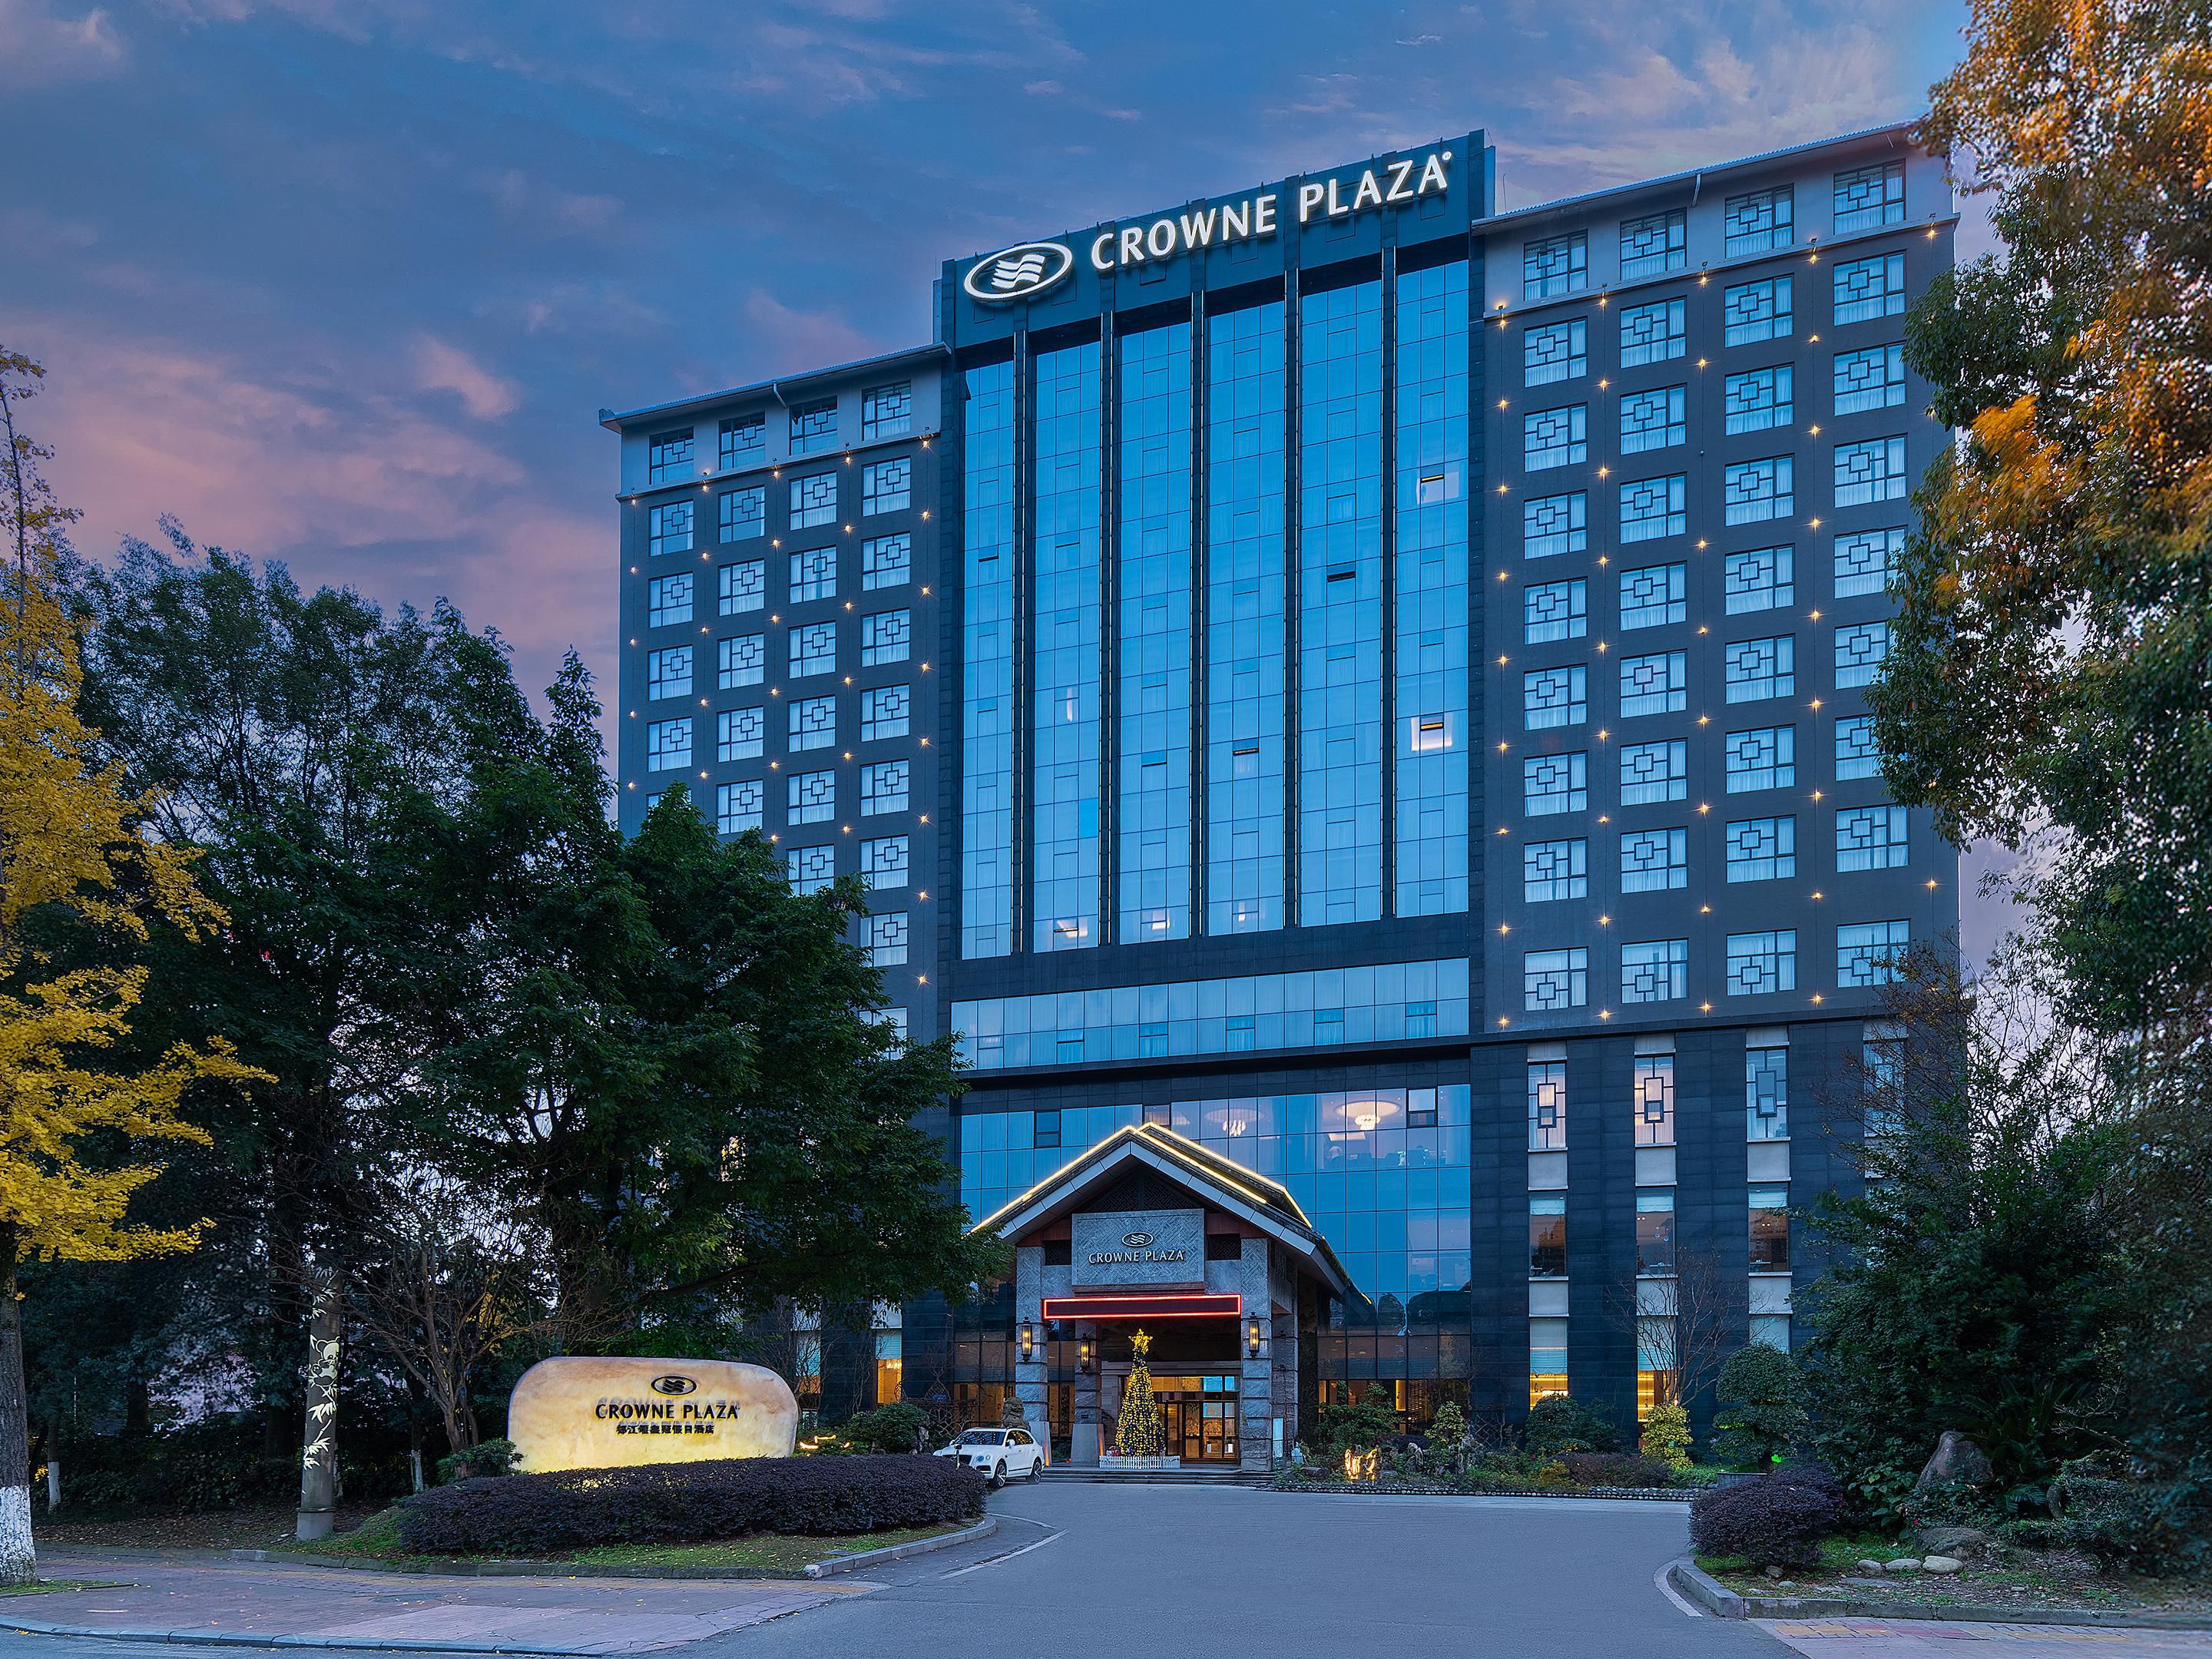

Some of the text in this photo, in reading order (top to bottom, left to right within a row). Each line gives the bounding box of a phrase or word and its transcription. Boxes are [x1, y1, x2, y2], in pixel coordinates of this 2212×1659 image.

[1091, 153, 1448, 270] CROWNE PLAZA
[1089, 1250, 1184, 1263] CROWNE PLAZA
[595, 1404, 738, 1419] CROWNE PLAZA
